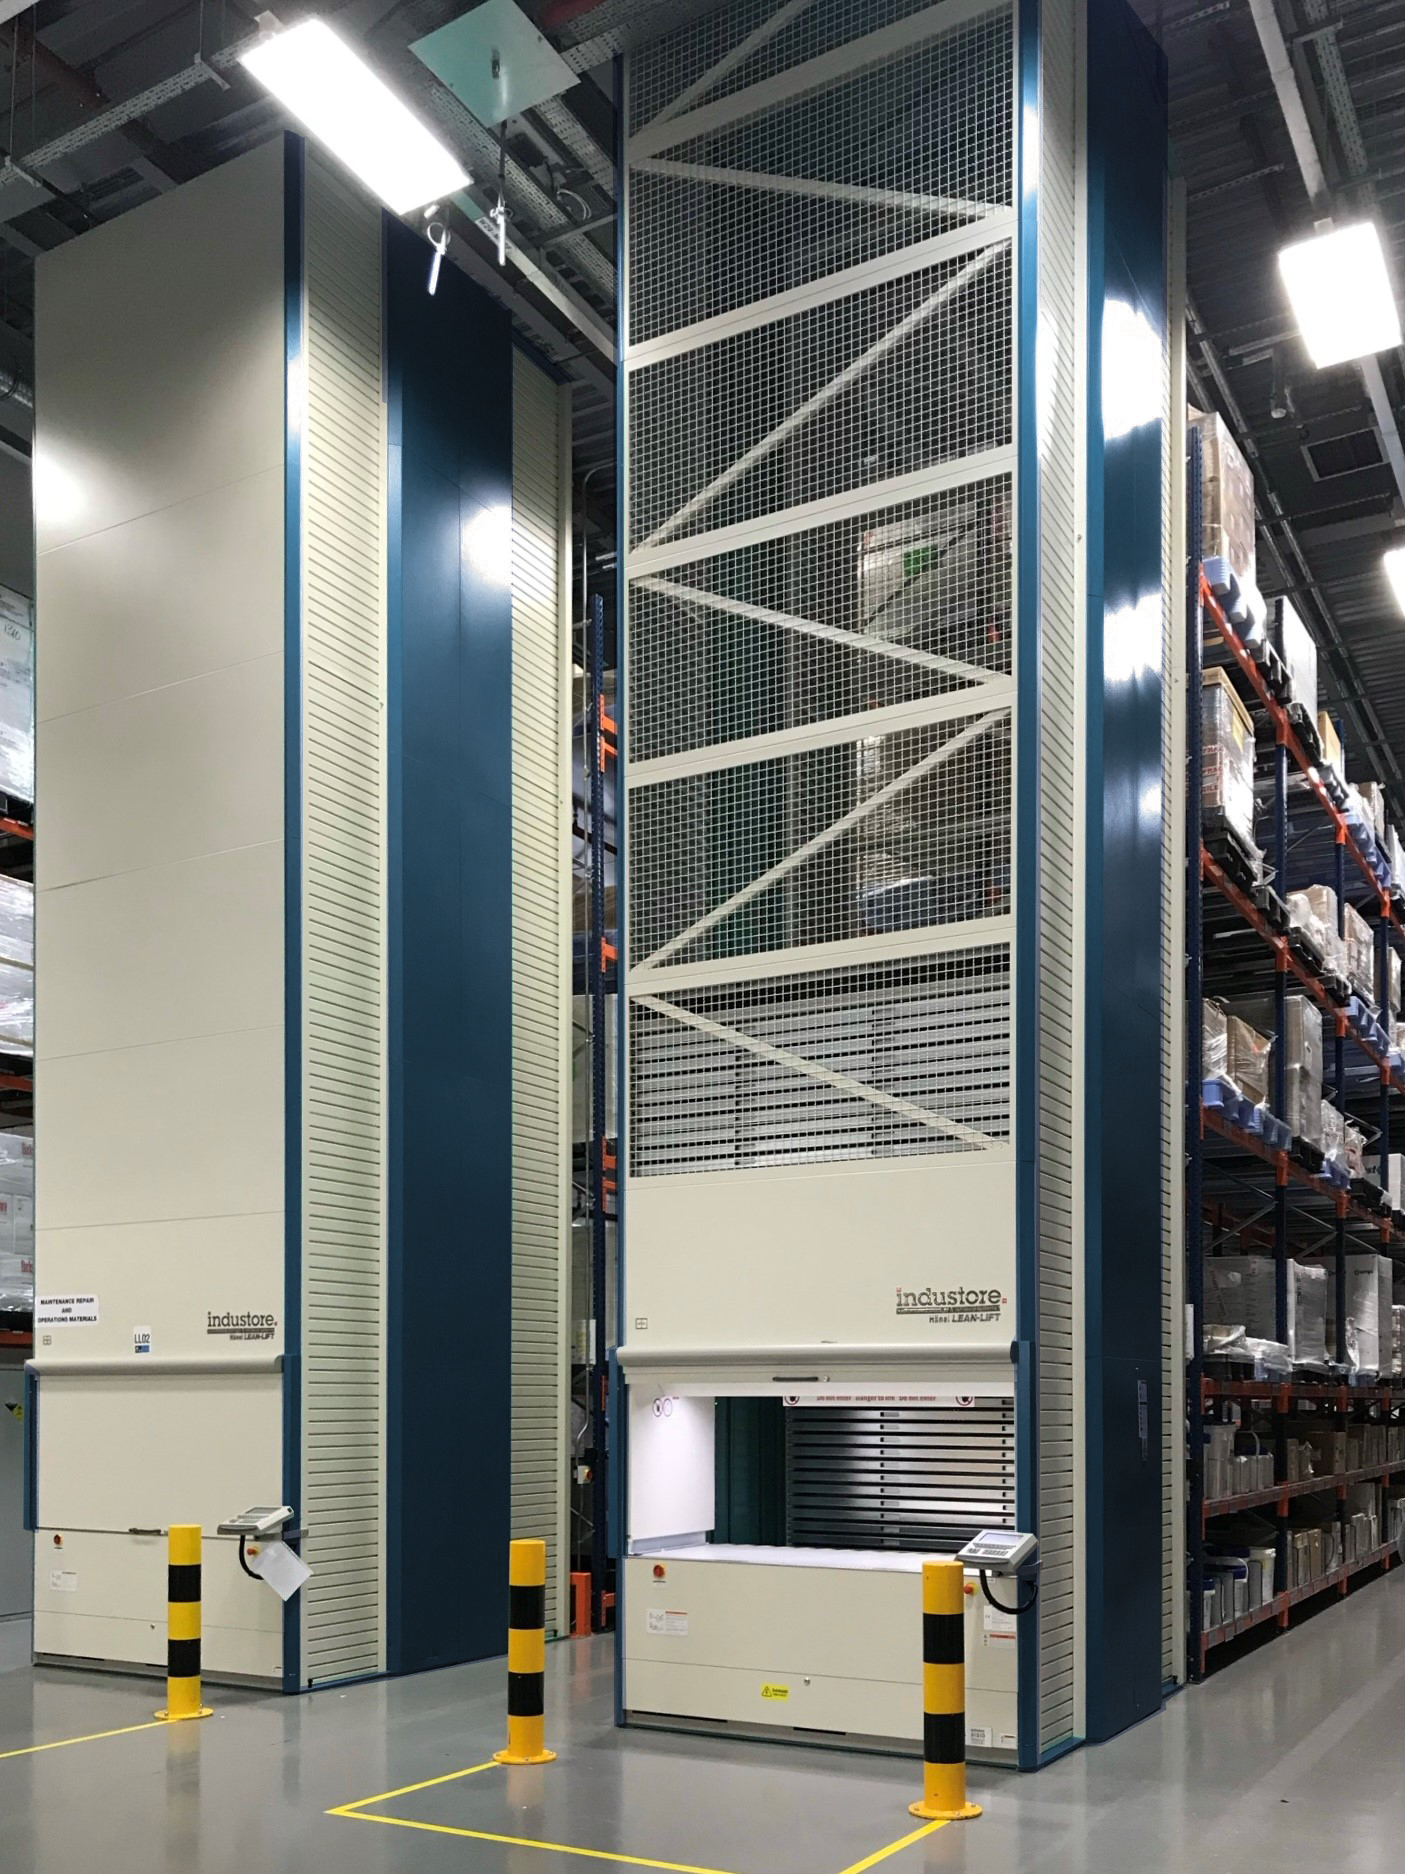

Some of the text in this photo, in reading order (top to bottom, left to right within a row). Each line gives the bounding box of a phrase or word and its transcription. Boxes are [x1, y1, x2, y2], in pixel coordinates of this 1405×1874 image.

[952, 1312, 1001, 1323] LEAN-LIFT
[134, 1333, 151, 1344] LL02
[244, 1333, 275, 1341] LEAN-LIFT
